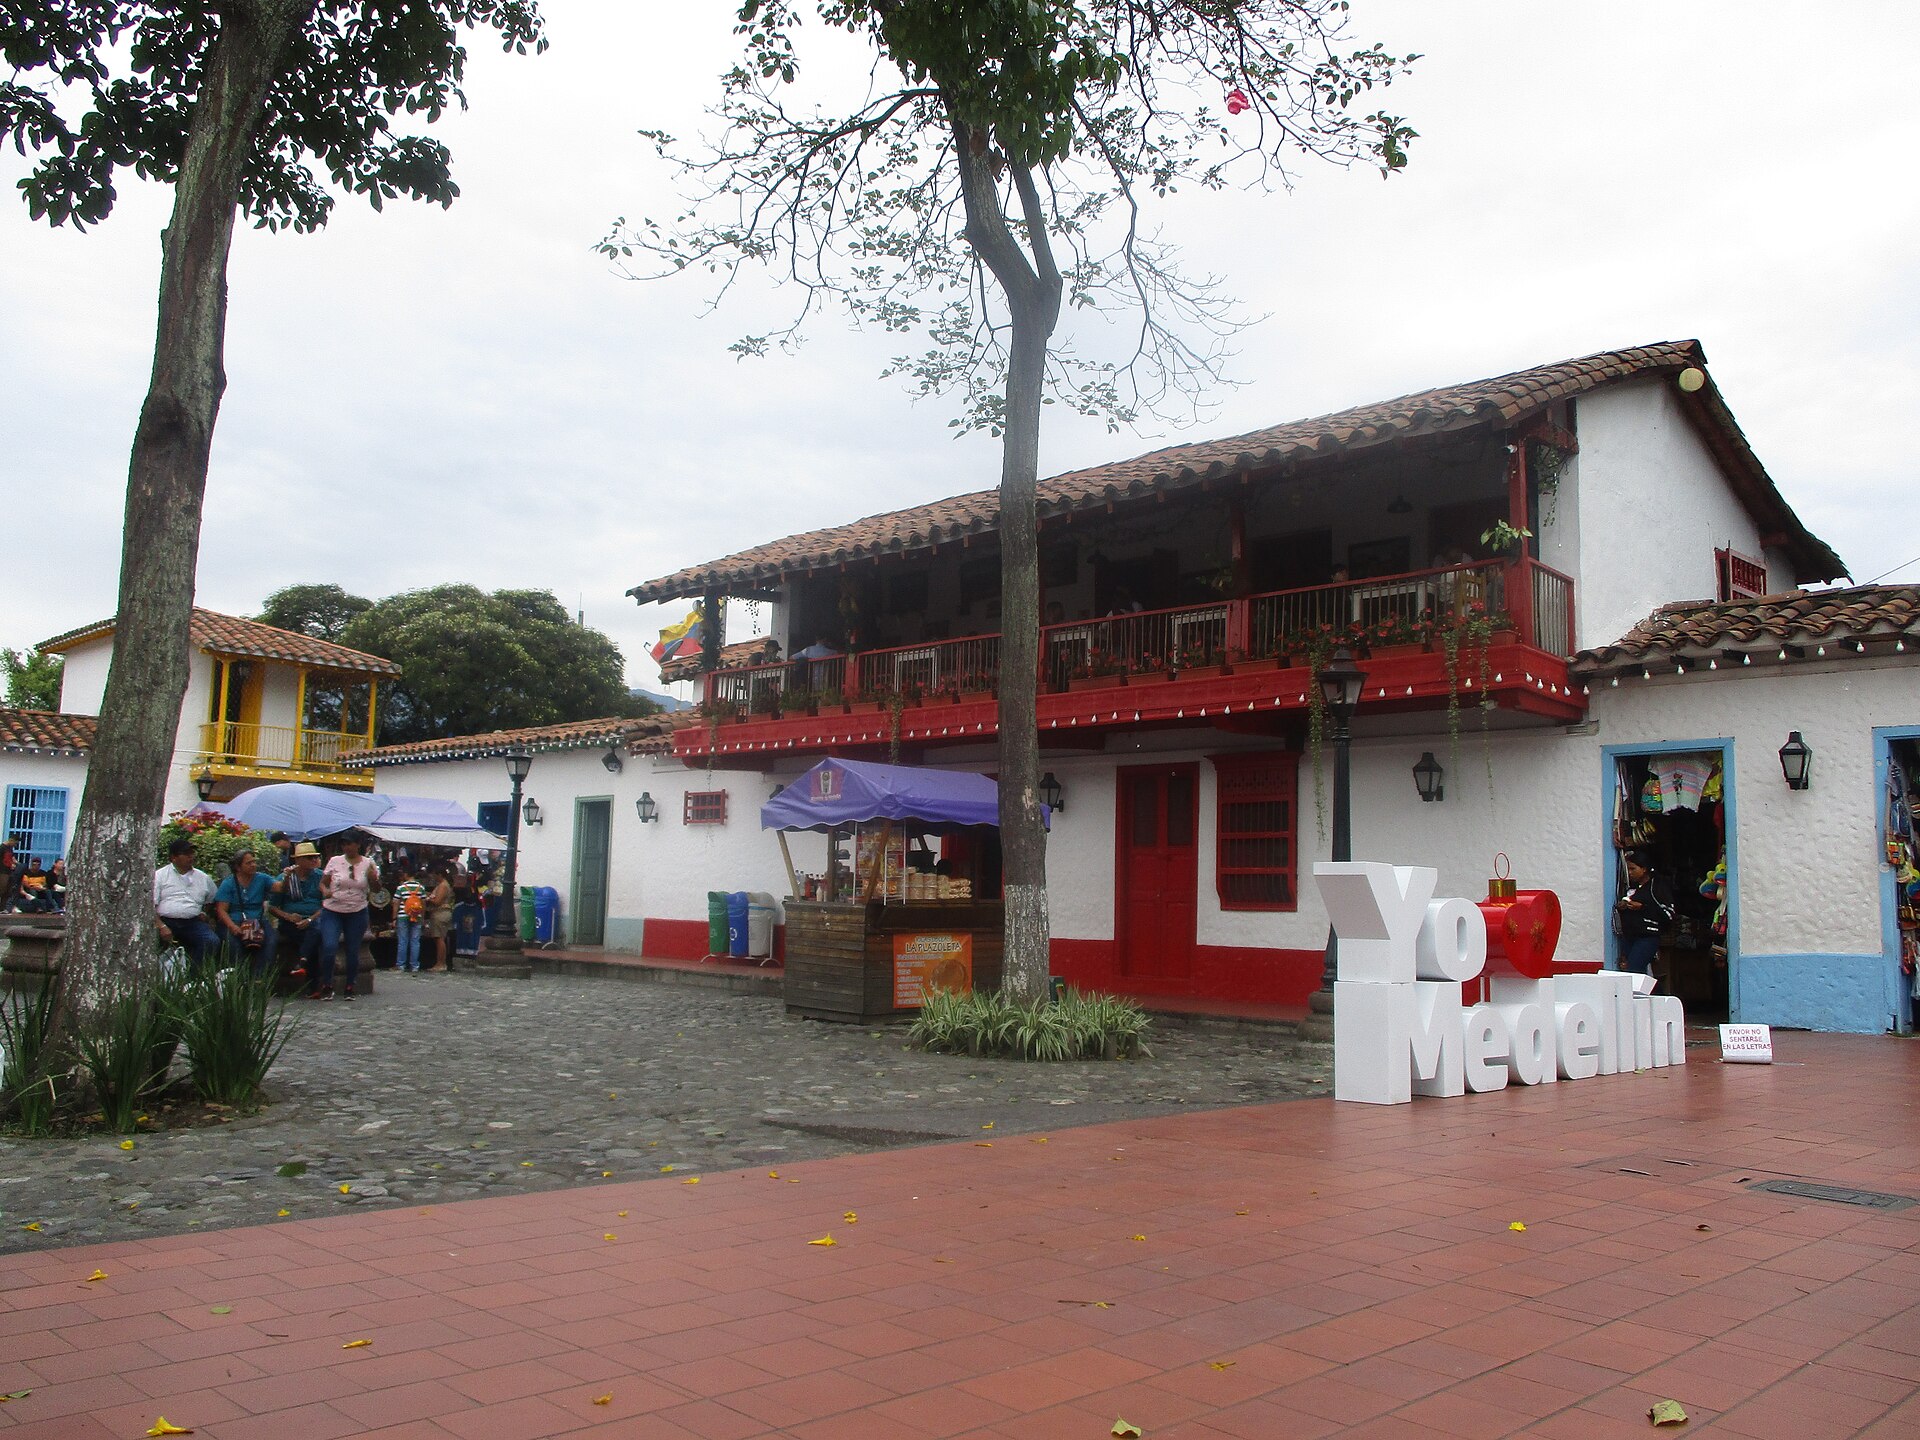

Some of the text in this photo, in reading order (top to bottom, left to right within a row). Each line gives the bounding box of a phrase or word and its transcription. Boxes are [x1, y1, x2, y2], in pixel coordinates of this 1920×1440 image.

[906, 941, 962, 953] LA PLAZOLETA
[1313, 862, 1487, 982] Yo
